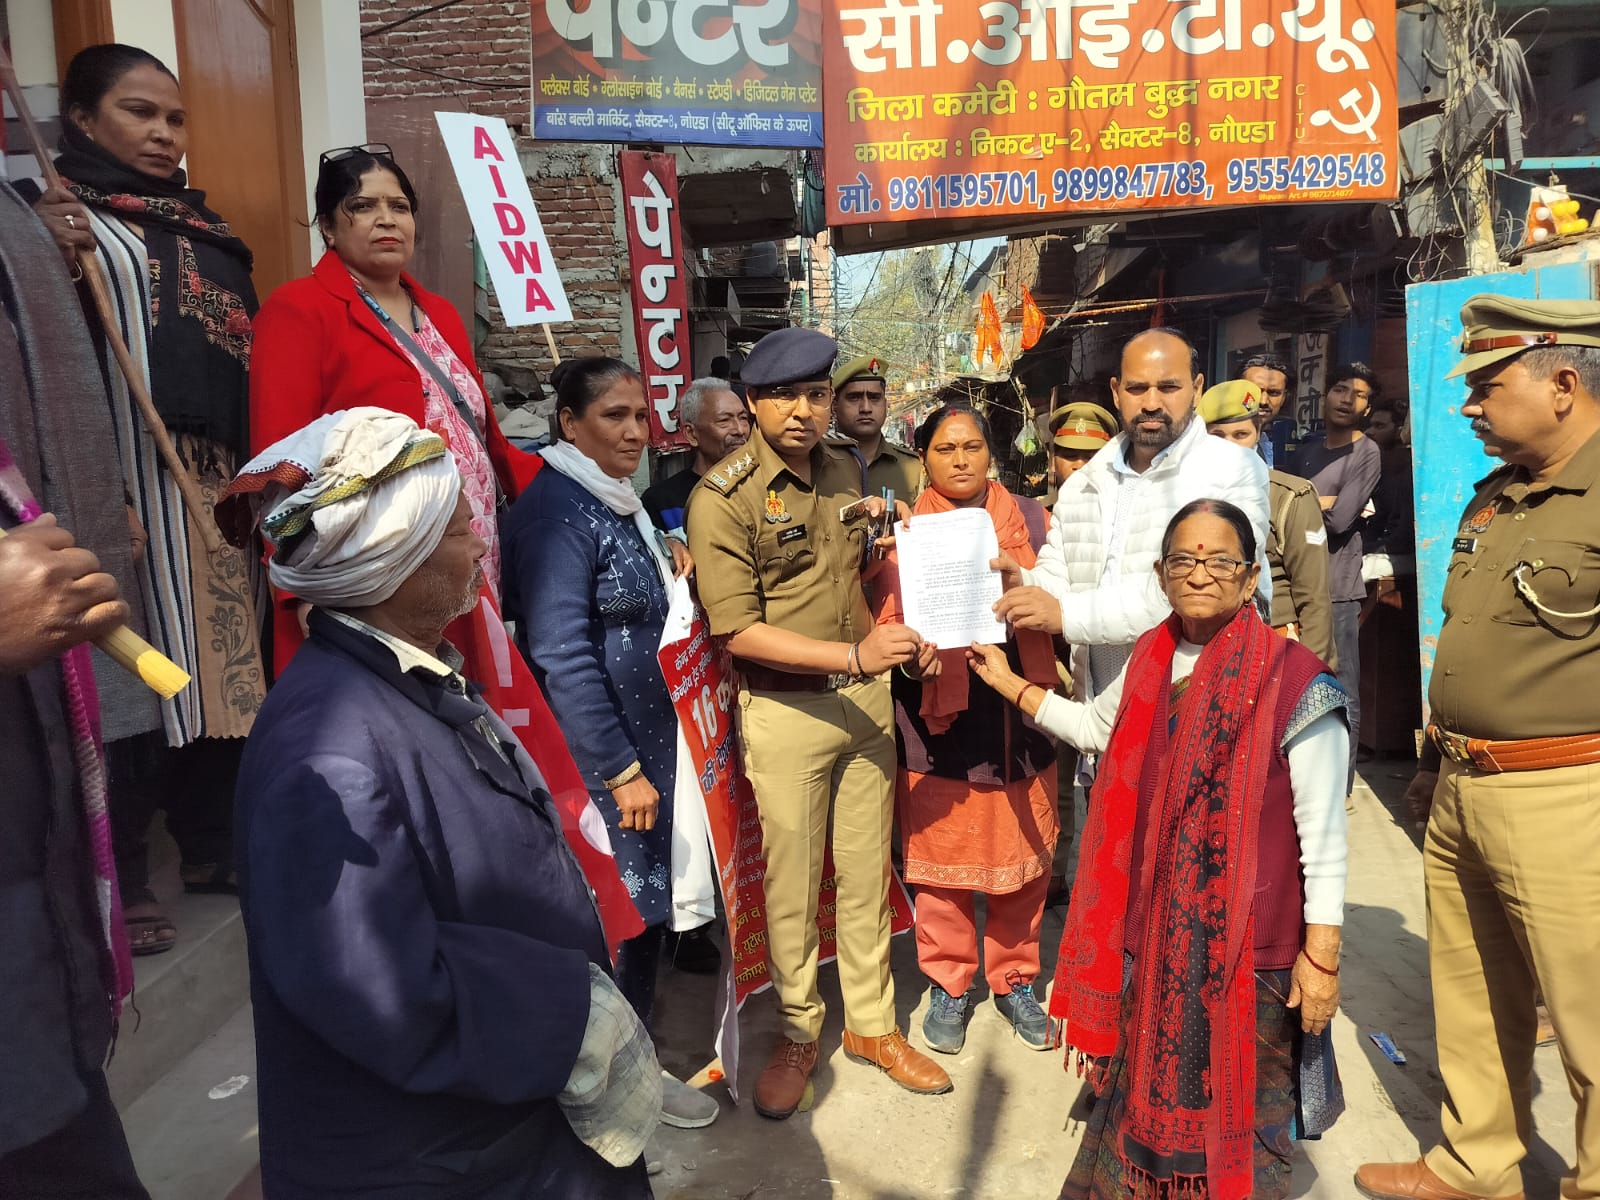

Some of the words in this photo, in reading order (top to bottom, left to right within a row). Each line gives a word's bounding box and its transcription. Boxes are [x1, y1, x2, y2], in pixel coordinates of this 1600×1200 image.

[781, 81, 796, 102] नेम
[847, 87, 926, 123] जिला
[932, 80, 1018, 117] कमेटी
[1047, 75, 1136, 110] गौतम
[1144, 79, 1200, 119] बुद्ध
[1207, 75, 1283, 102] नगर
[568, 108, 595, 126] बल्ली
[680, 111, 709, 130] नोएडा
[773, 113, 784, 131] के
[854, 131, 948, 163] कार्यालय
[970, 127, 1036, 157] निकट
[1208, 114, 1276, 143] नौएडा
[889, 170, 1046, 212] 9811595701,
[1053, 160, 1214, 202] 9899847783,
[1227, 152, 1385, 194] 9555429548
[473, 126, 556, 313] AIDWA
[692, 684, 718, 751] 16
